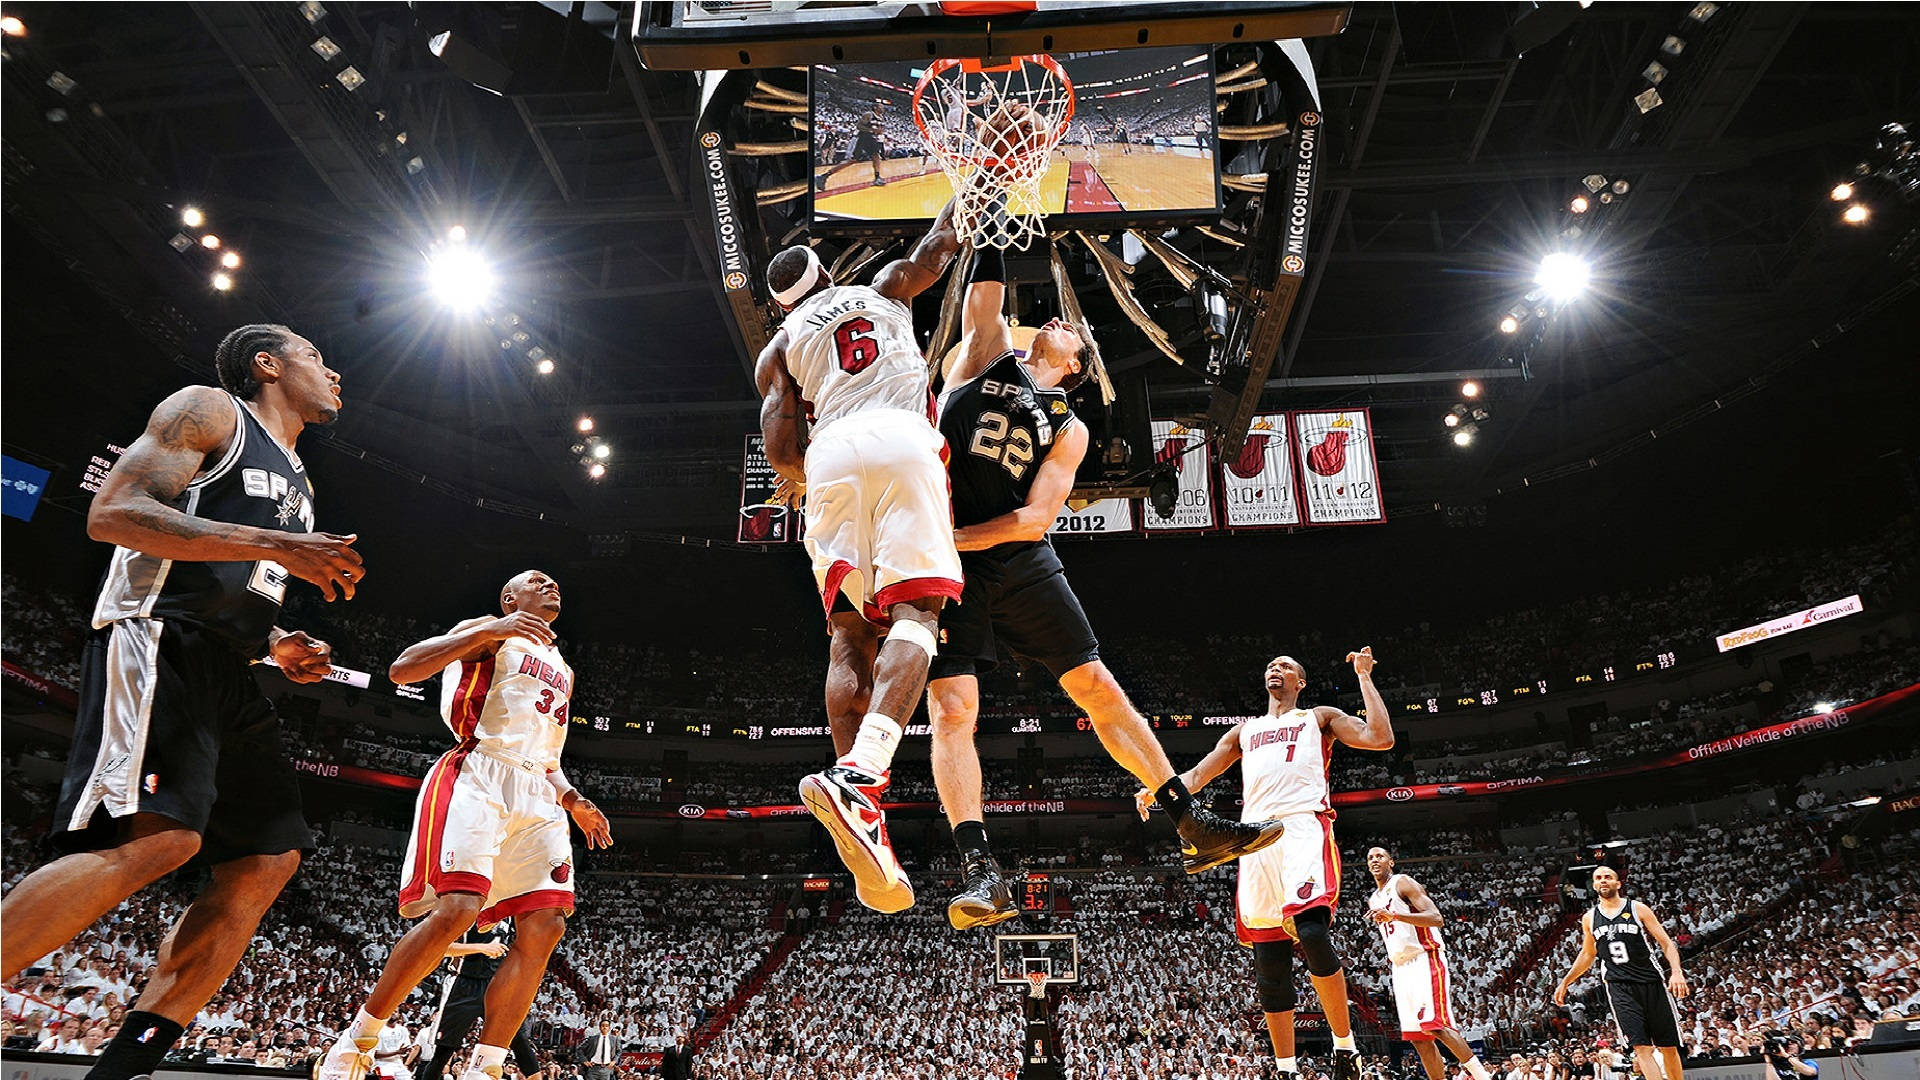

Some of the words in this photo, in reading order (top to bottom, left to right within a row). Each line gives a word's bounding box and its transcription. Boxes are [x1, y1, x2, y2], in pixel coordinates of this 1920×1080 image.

[1287, 129, 1315, 254] MICCOSUKEE.COM
[707, 148, 741, 270] MICCOSUKEE.COM
[806, 300, 866, 331] JAMES
[833, 316, 880, 376] 6
[968, 409, 1034, 481] 22
[90, 455, 111, 469] REB
[1183, 489, 1206, 507] 06
[1232, 487, 1254, 504] 10
[1269, 486, 1289, 502] 11
[1313, 483, 1333, 500] 11
[1350, 481, 1373, 500] 12
[1148, 515, 1208, 526] CHAMPIONS
[1232, 512, 1293, 522] CHAMPIONS
[1313, 507, 1377, 519] CHAMPIONS
[1056, 515, 1105, 532] 2012
[246, 559, 289, 607] 2
[1813, 602, 1854, 621] Carnival
[519, 654, 569, 698] HEA
[1575, 674, 1592, 683] FTA
[1604, 666, 1613, 675] 14
[1604, 673, 1615, 682] 11
[1513, 687, 1530, 695] FTM
[1537, 680, 1547, 688] 11
[535, 689, 567, 727] 34
[686, 725, 700, 733] FTA
[770, 726, 823, 737] OFFENSIVE
[1019, 719, 1039, 727] 8:21
[1250, 723, 1306, 752] HEAT
[1689, 740, 1733, 759] Official
[1733, 729, 1781, 749] Vehicle
[1783, 724, 1798, 737] of
[1286, 744, 1296, 763] 1
[1486, 775, 1544, 790] OPTIMA
[1390, 789, 1411, 799] KIA
[682, 806, 701, 816] KIA
[1014, 802, 1026, 813] of
[1027, 884, 1048, 893] 8:21
[1608, 941, 1630, 964] 9
[1041, 1056, 1048, 1064] TV
